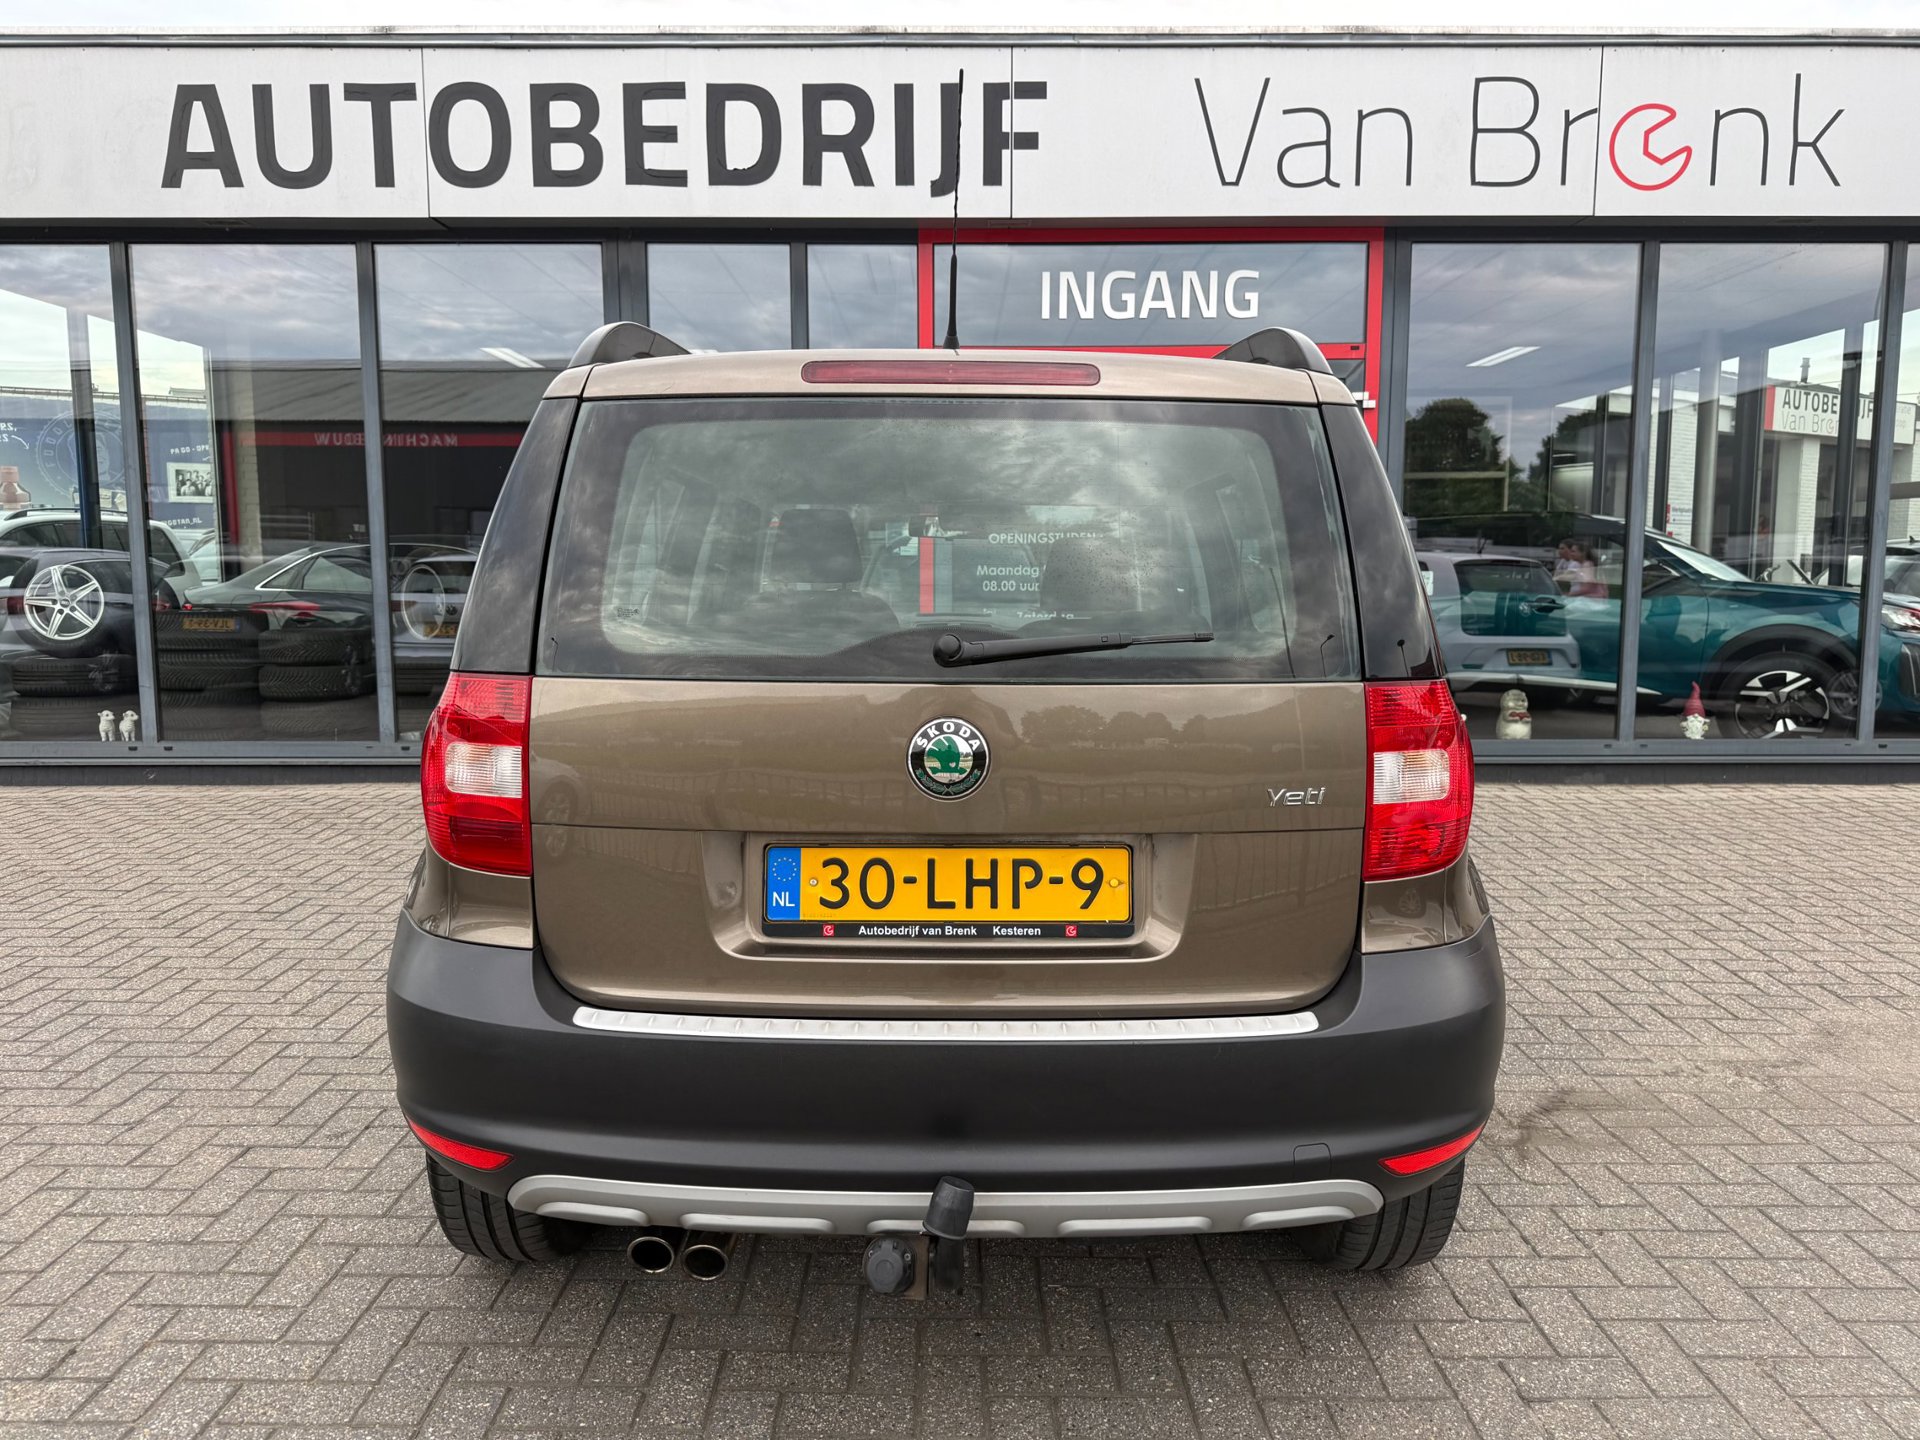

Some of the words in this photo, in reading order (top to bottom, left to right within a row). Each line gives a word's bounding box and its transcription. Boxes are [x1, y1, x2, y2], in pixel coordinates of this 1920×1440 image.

[160, 81, 1048, 198] AUTOBEDRIJF
[1194, 76, 1413, 188] Van
[1040, 269, 1260, 321] INGANG
[976, 564, 1040, 579] Maandag
[982, 580, 1017, 592] 08.00
[1267, 787, 1326, 807] Yeti
[819, 857, 1105, 910] 30-LHP-9
[772, 892, 795, 908] NL
[858, 925, 920, 937] Autobedrijf
[922, 928, 942, 936] van
[945, 925, 978, 936] Brenk
[993, 925, 1042, 936] Kesteren
